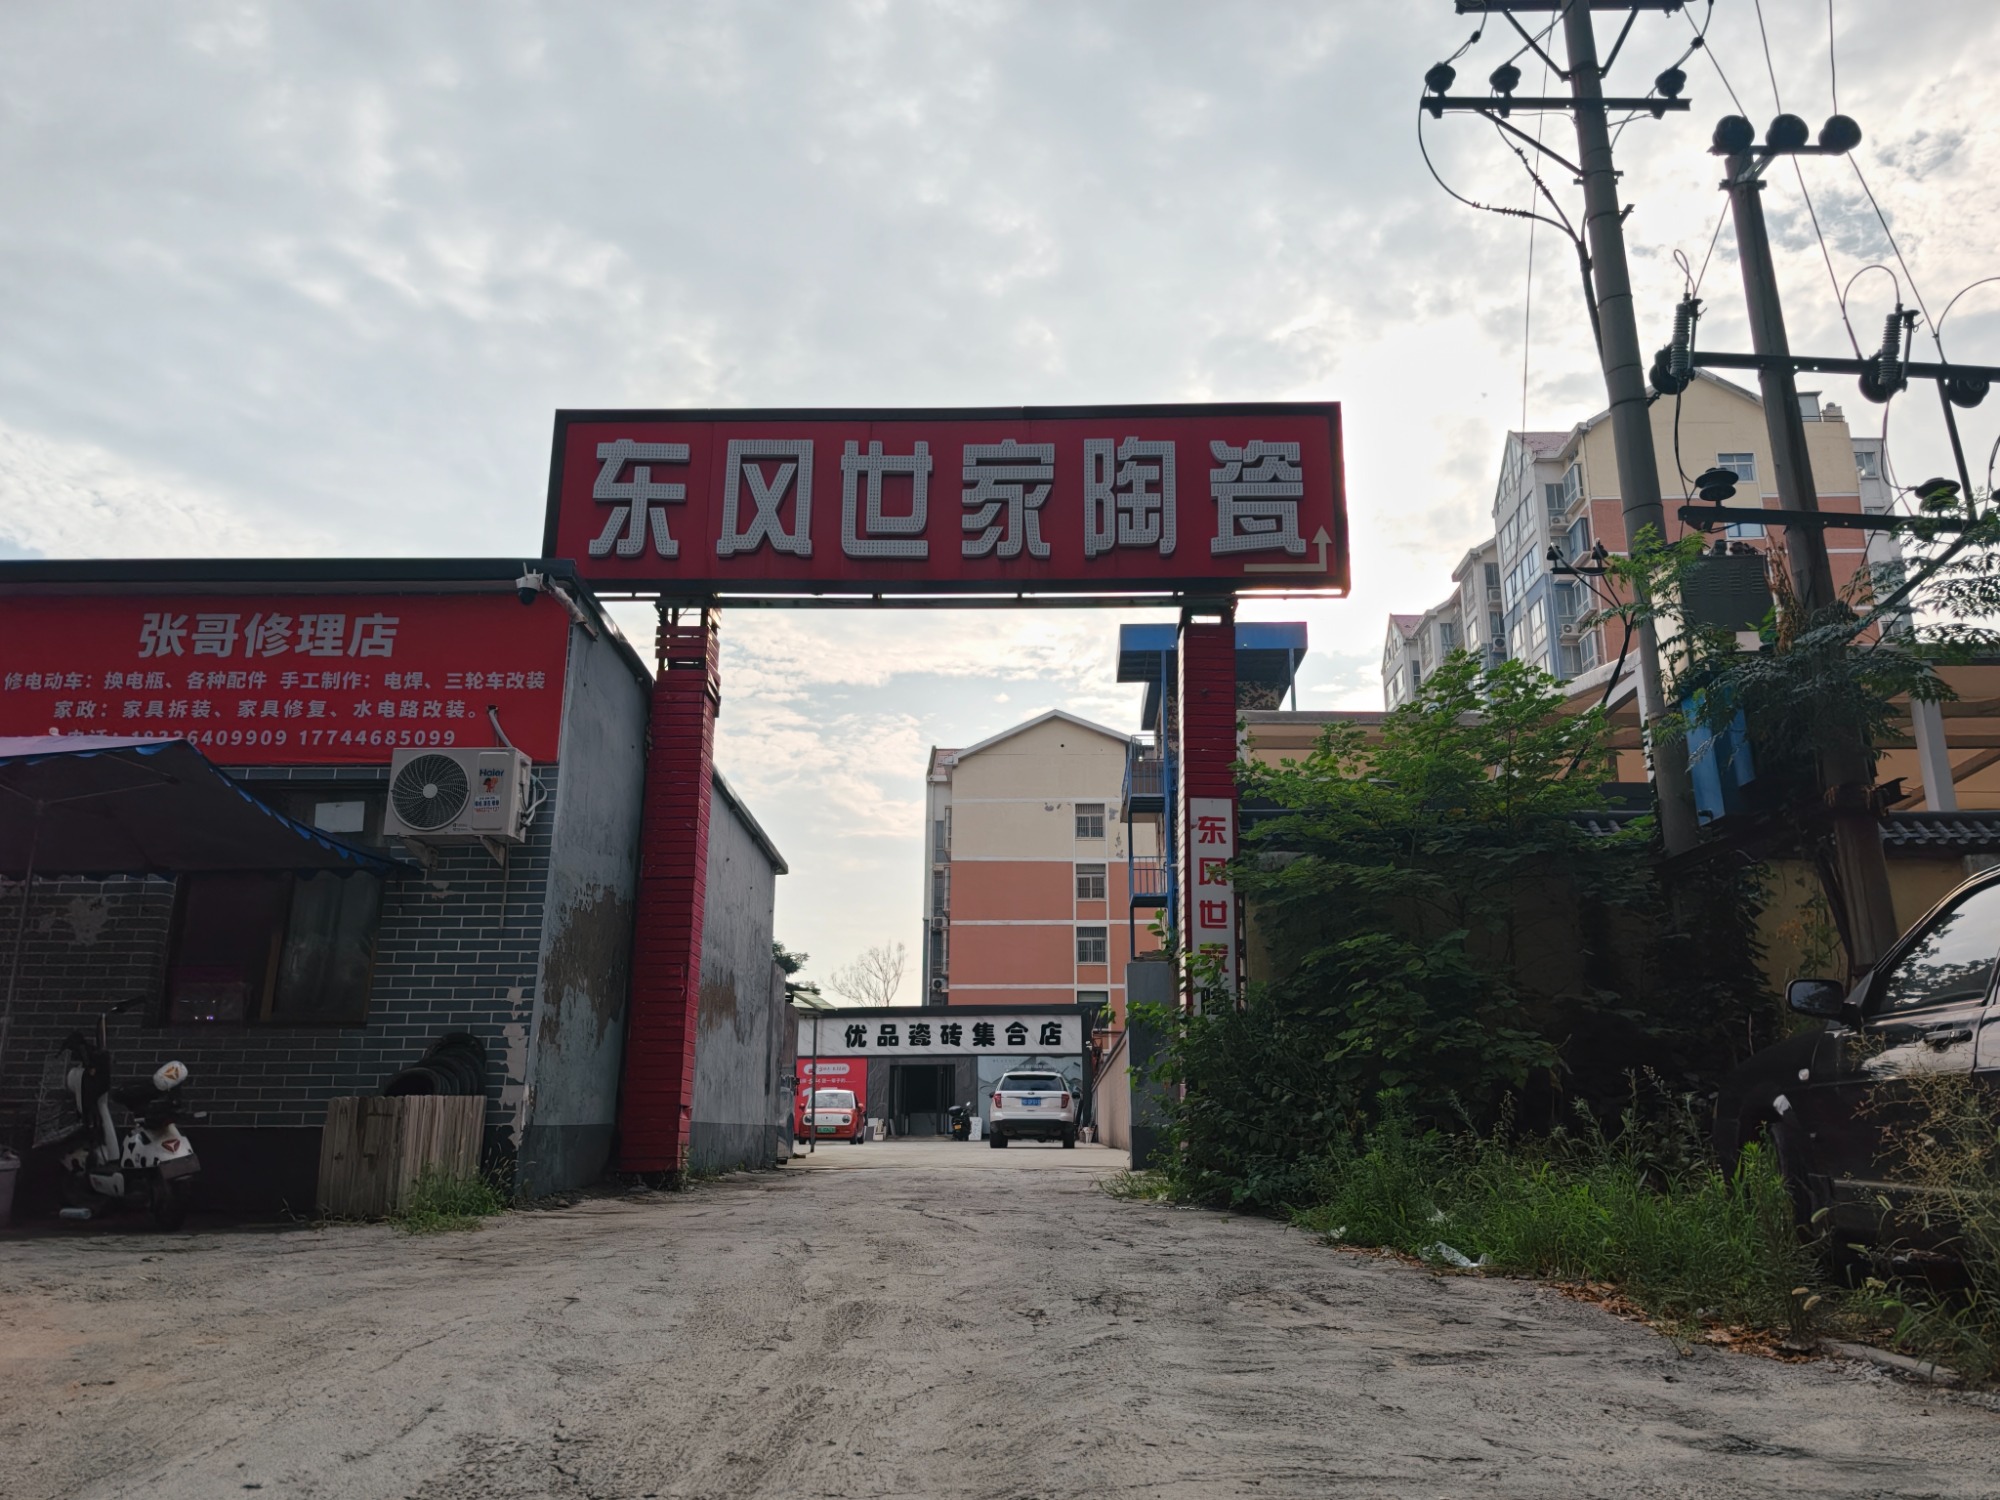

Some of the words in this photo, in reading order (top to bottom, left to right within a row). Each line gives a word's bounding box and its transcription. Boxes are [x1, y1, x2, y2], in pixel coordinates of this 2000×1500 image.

[588, 436, 1307, 559] 东风世家陶瓷
[138, 612, 400, 658] 张哥修理店
[299, 730, 456, 746] 17744685099
[479, 767, 505, 777] Haier
[844, 1021, 1063, 1048] 优品瓷砖集合店
